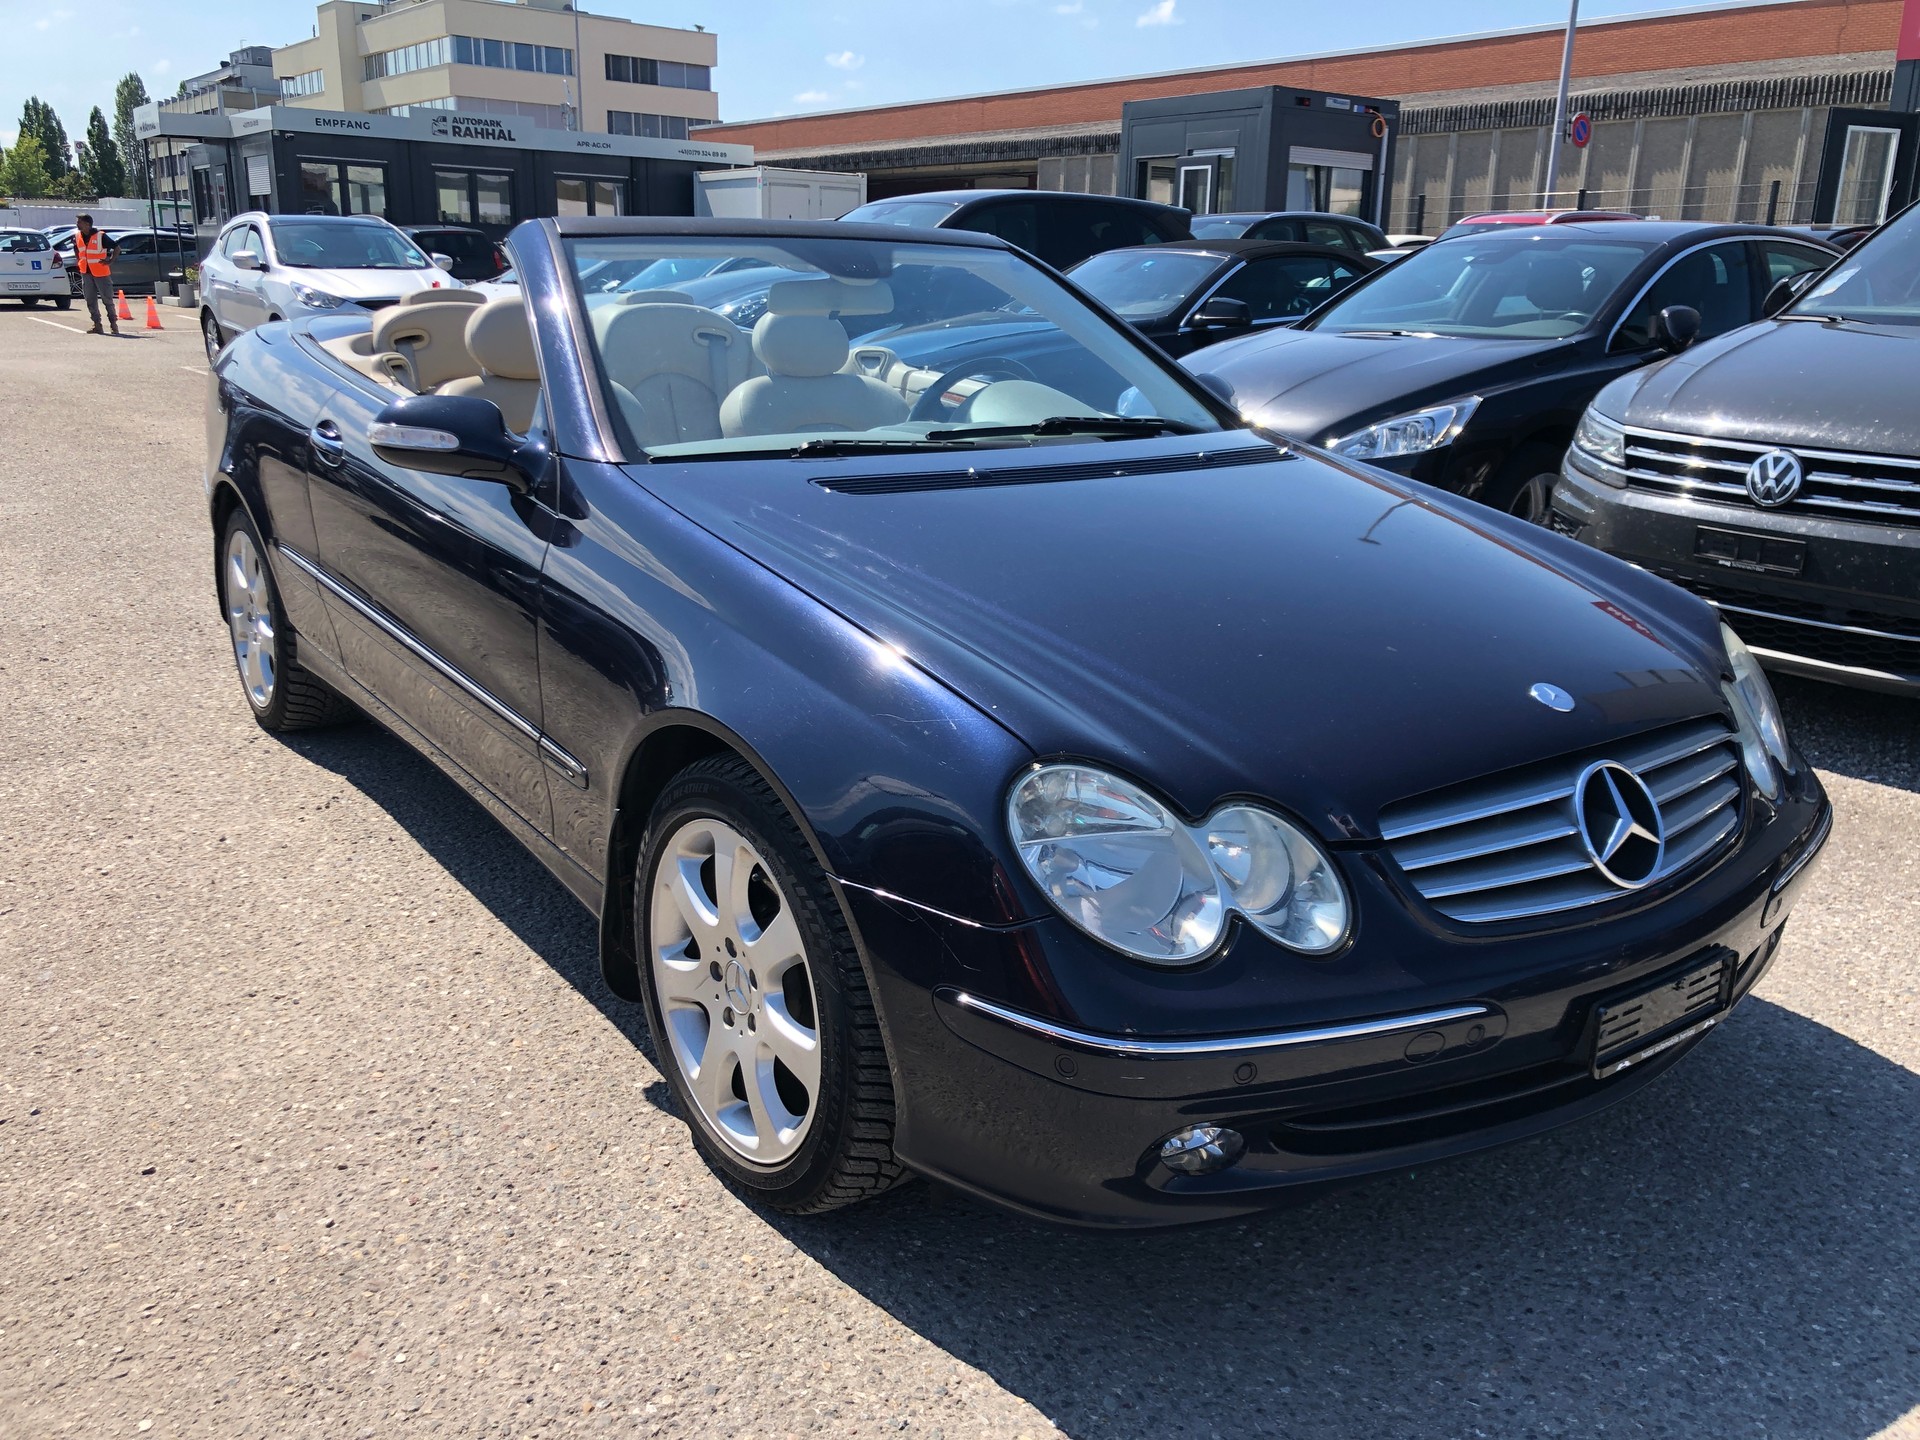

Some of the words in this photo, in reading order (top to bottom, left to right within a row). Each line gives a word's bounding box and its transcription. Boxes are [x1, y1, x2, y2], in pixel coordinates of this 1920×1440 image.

[315, 117, 371, 130] EMPFANG
[452, 116, 502, 128] AUTOPARK
[452, 126, 516, 142] RAHHAL
[577, 140, 611, 149] APR-AG.CH
